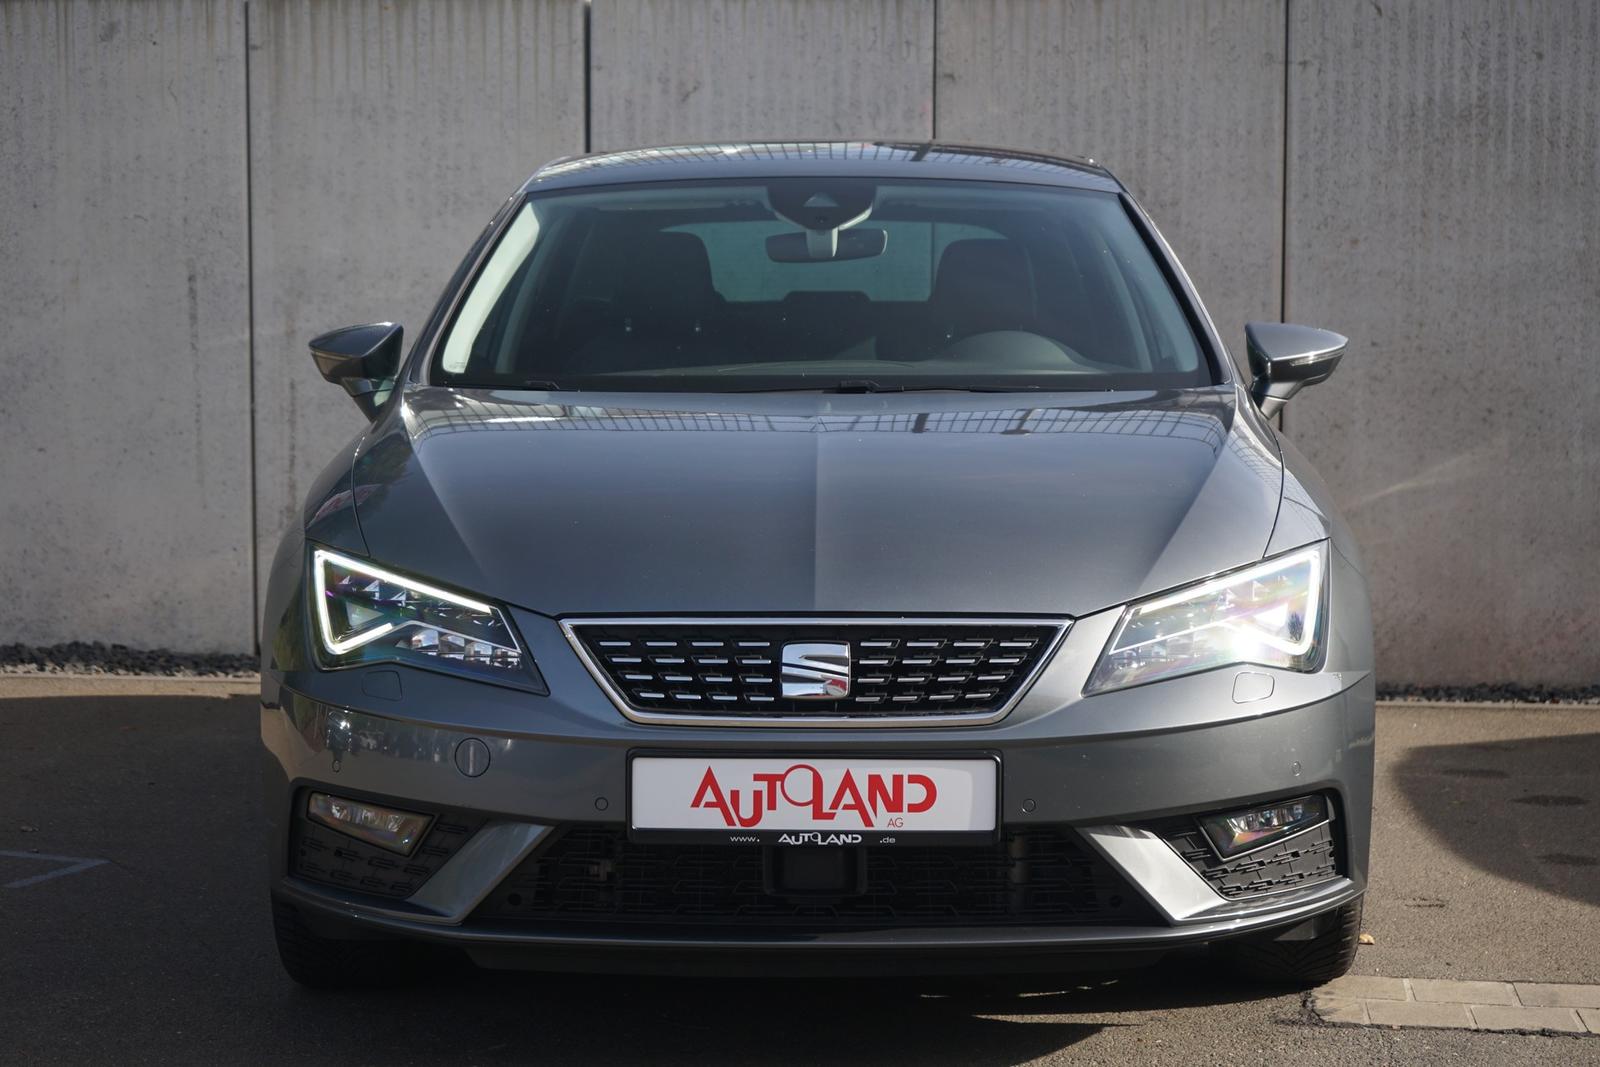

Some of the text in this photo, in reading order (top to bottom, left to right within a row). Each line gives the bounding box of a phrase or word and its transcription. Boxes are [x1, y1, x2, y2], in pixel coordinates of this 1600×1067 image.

[691, 764, 938, 828] AUTOLAND
[887, 817, 904, 828] AG
[729, 832, 896, 846] www. AUTOLAND .de
